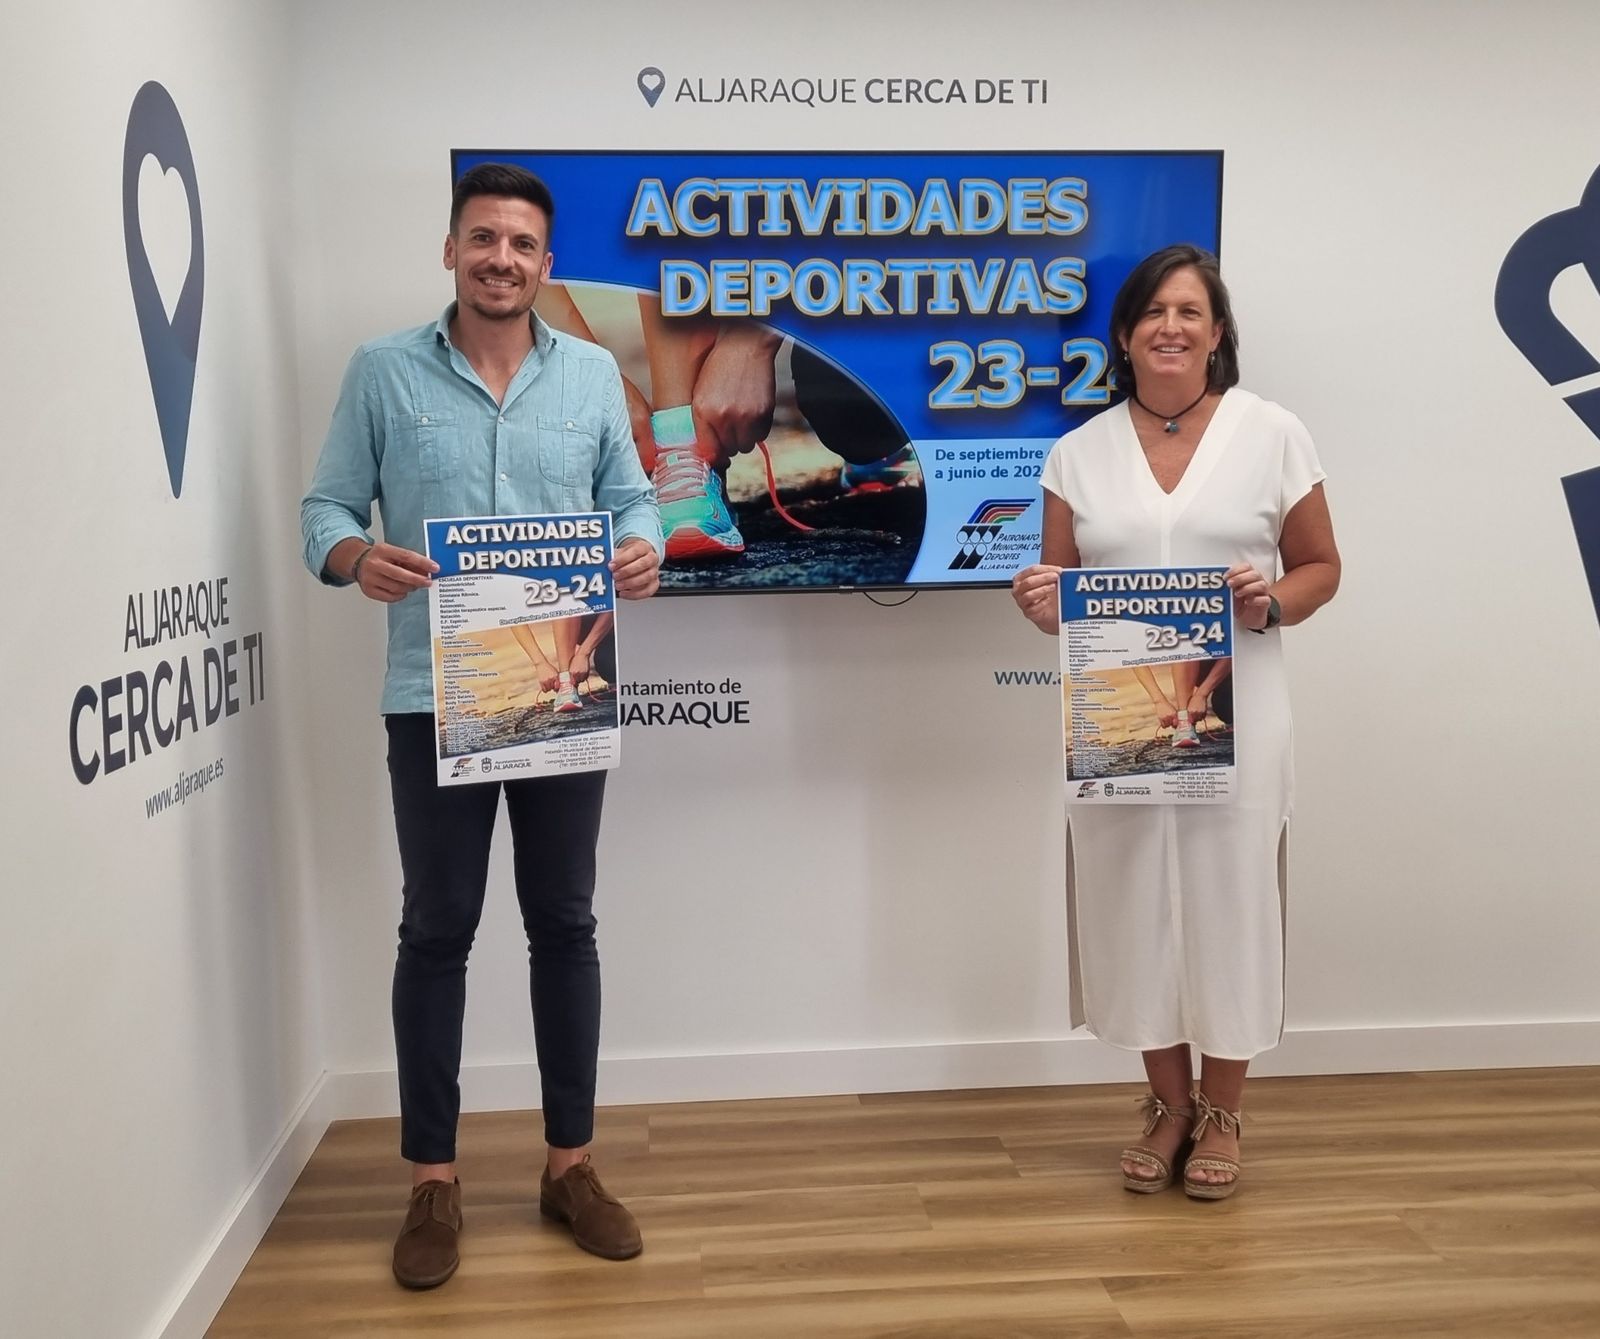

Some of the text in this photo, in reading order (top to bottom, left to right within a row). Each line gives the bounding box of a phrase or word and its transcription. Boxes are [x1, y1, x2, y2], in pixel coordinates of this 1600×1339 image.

[675, 78, 1048, 108] ALJARAQUE CERCA DE TI
[626, 176, 1089, 237] ACTIVIDADES
[659, 257, 1088, 316] DEPORTIVAS
[928, 336, 1118, 409] 23-2
[936, 449, 954, 461] De
[960, 447, 1044, 462] septiembre
[935, 465, 1044, 482] a junio de 202
[446, 519, 603, 544] ACTIVIDADES
[458, 545, 604, 570] DEPORTIVAS
[526, 572, 606, 606] 23-24
[1076, 572, 1224, 592] ACTIVIDADES
[124, 577, 229, 653] ALJARAQUE
[1086, 596, 1224, 616] DEPORTIVAS
[1146, 621, 1224, 651] 23-24
[620, 678, 741, 696] ntamiento de
[70, 632, 264, 785] CERCA DE TI
[620, 700, 750, 728] JARAQUE
[494, 762, 532, 770] ALJARAQUE
[145, 757, 224, 819] www.aljaraque.es
